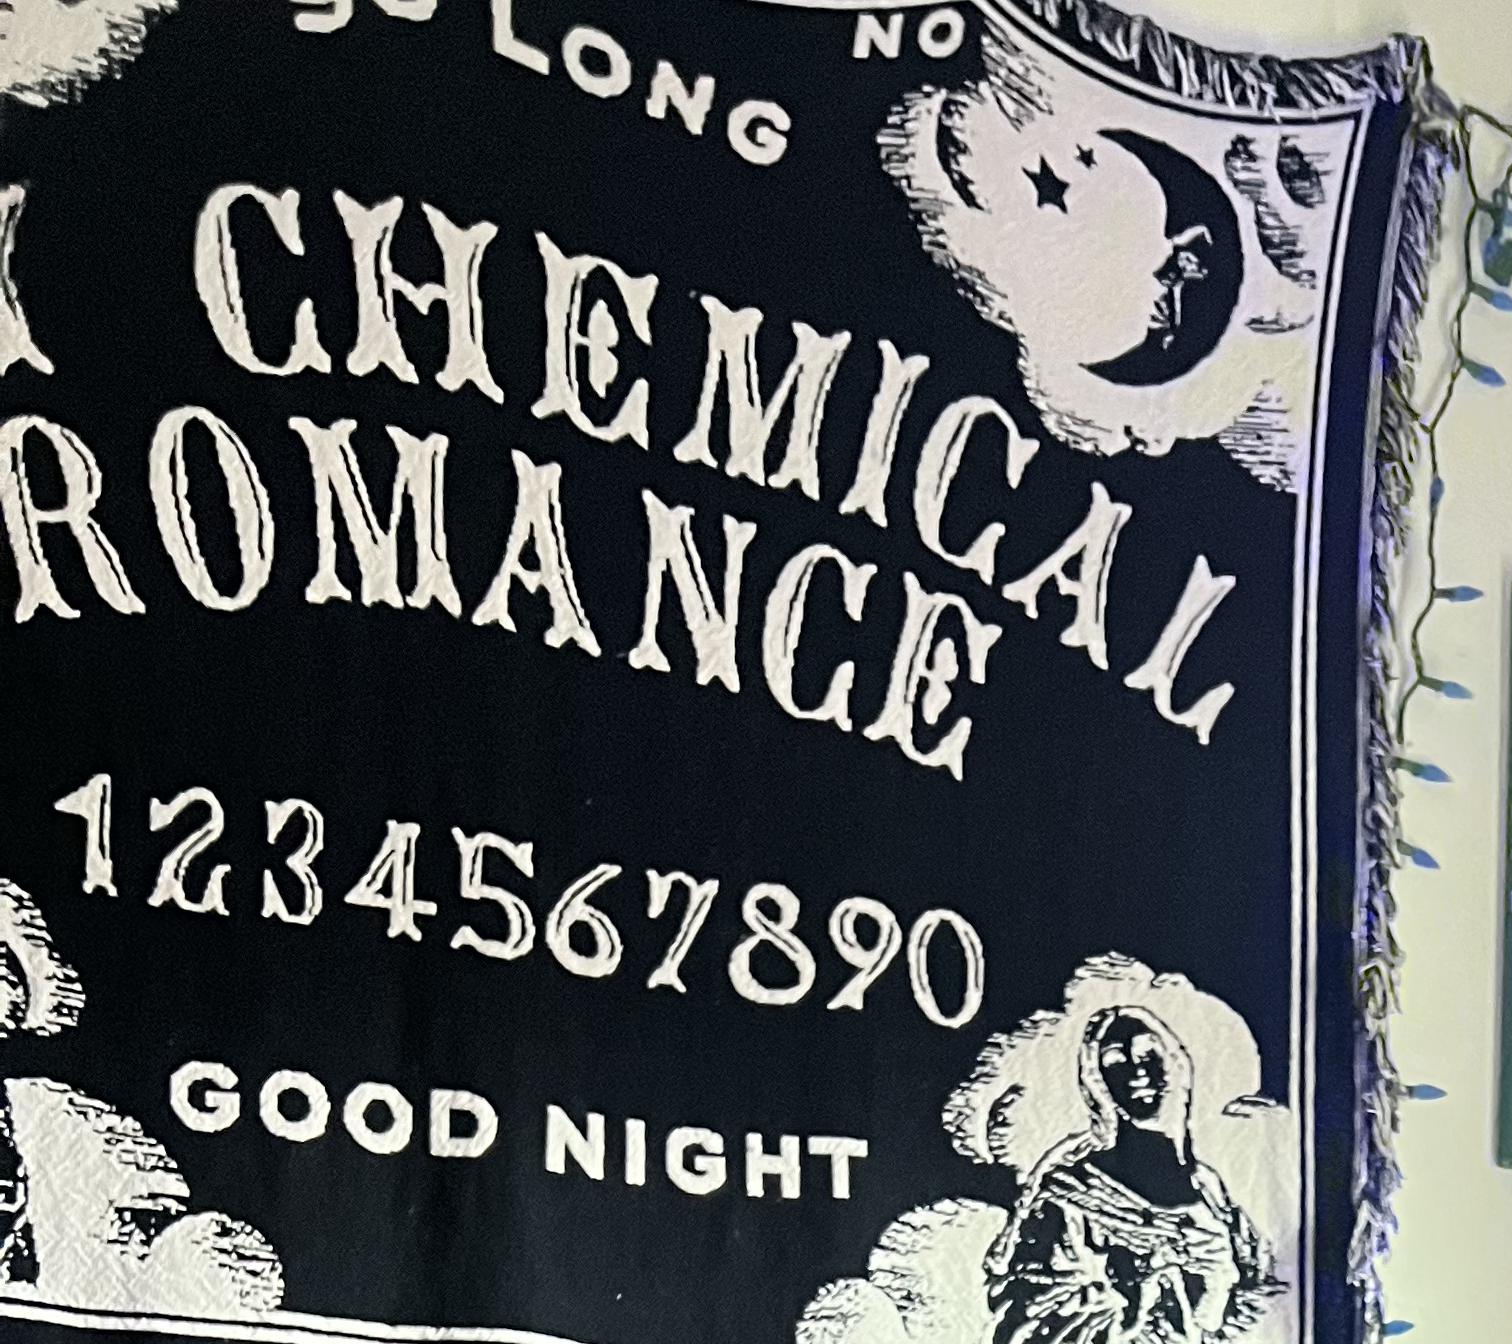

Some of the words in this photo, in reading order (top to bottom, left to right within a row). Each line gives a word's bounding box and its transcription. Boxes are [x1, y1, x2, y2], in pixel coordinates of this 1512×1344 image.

[489, 0, 793, 167] LONG
[851, 7, 967, 60] NO
[193, 183, 1238, 747] CHEMICAL
[0, 405, 1004, 783] ROMANCE
[53, 773, 986, 1030] 1234567890
[168, 1060, 500, 1160] GOOD
[544, 1103, 870, 1201] NIGHT
